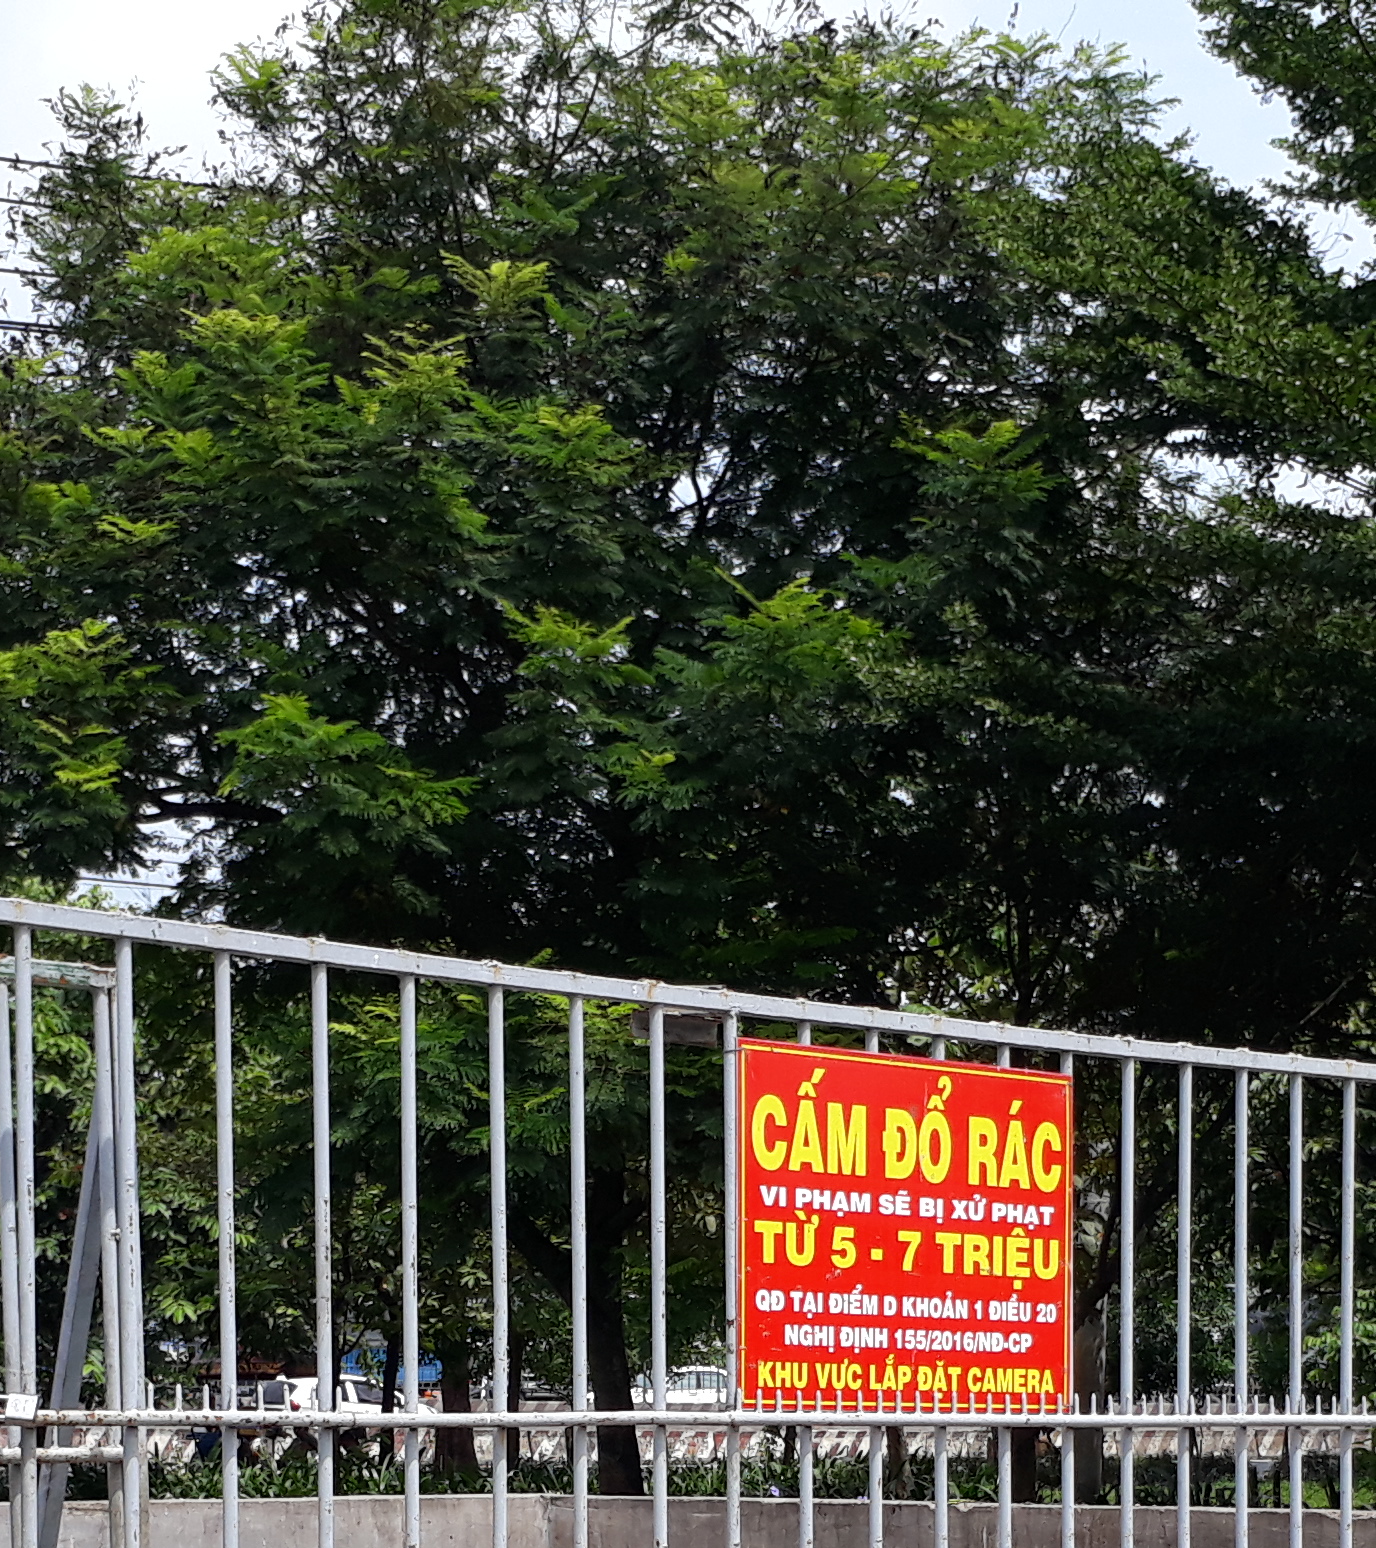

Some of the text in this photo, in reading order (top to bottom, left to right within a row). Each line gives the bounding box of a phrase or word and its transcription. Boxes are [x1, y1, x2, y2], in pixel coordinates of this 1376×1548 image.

[751, 1068, 1062, 1193] CẤM ĐỔ RÁC
[759, 1185, 1055, 1230] VI PHẠM SẼ BỊ XỬ PHẠT
[754, 1210, 820, 1267] TỪ
[830, 1226, 857, 1269] 5
[897, 1230, 922, 1272] 7
[935, 1227, 1059, 1290] TRIỆU
[755, 1289, 785, 1312] QĐ
[789, 1291, 823, 1319] TẠI
[828, 1284, 879, 1316] ĐIỂM
[883, 1295, 897, 1316] D
[902, 1290, 969, 1320] KHOẢN
[974, 1300, 983, 1320] 1
[1035, 1303, 1057, 1323] 20
[784, 1324, 1033, 1354] NGHỊ ĐỊNH 155/2016/NĐ-CP
[757, 1361, 808, 1389] KHU
[869, 1354, 912, 1391] LẮP
[917, 1360, 962, 1399] ĐẶT
[967, 1366, 1055, 1394] CAMERA
